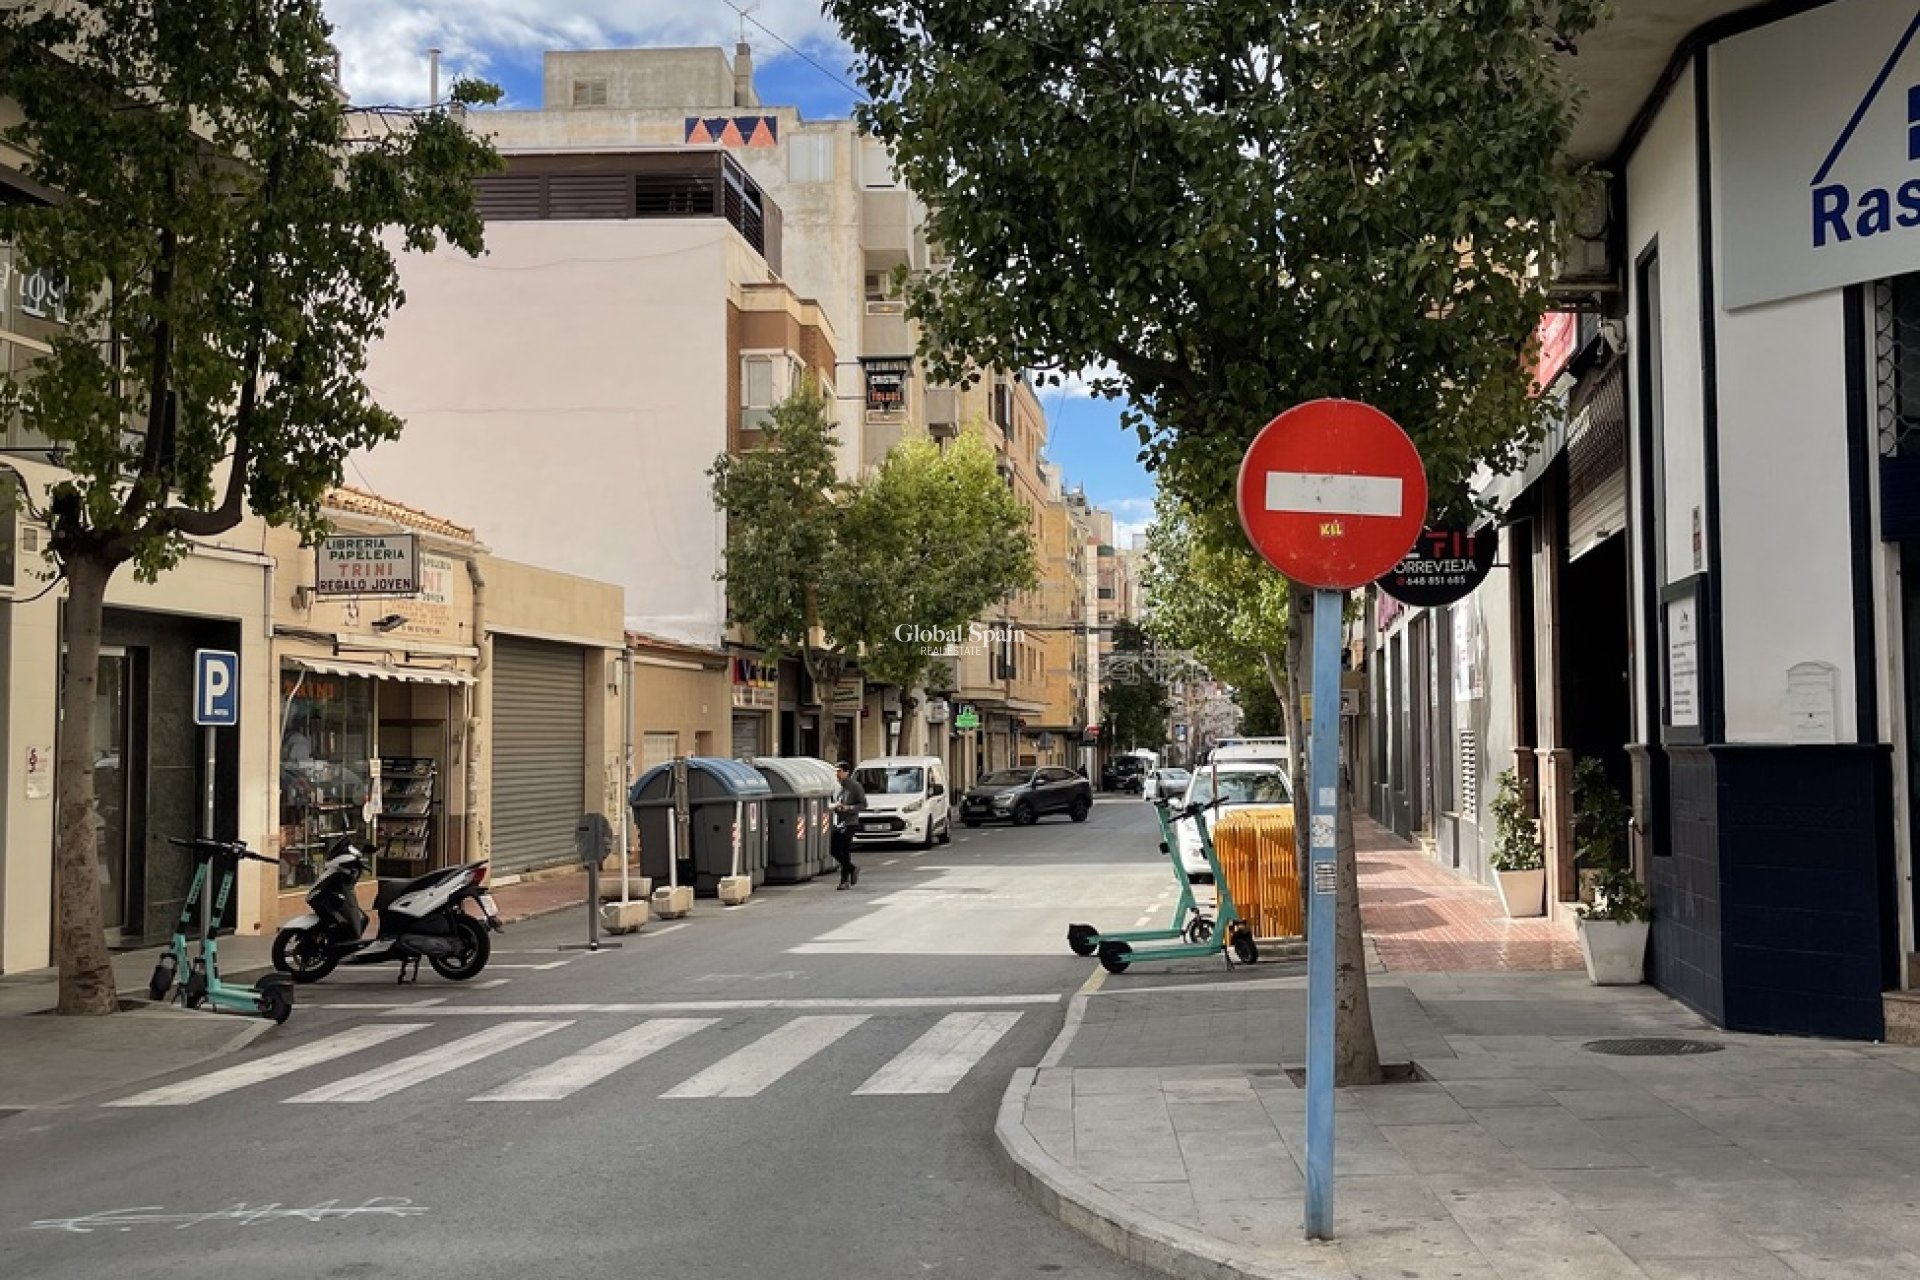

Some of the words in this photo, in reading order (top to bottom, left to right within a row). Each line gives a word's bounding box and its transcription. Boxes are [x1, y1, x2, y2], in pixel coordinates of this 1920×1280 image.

[326, 539, 386, 550] LIBRERIA
[330, 549, 404, 560] PAPELERIA
[338, 562, 393, 577] TRINI
[1393, 559, 1478, 573] ORREVIEJA
[320, 579, 366, 591] REGALO
[371, 578, 411, 590] JOVEN
[204, 659, 229, 716] P
